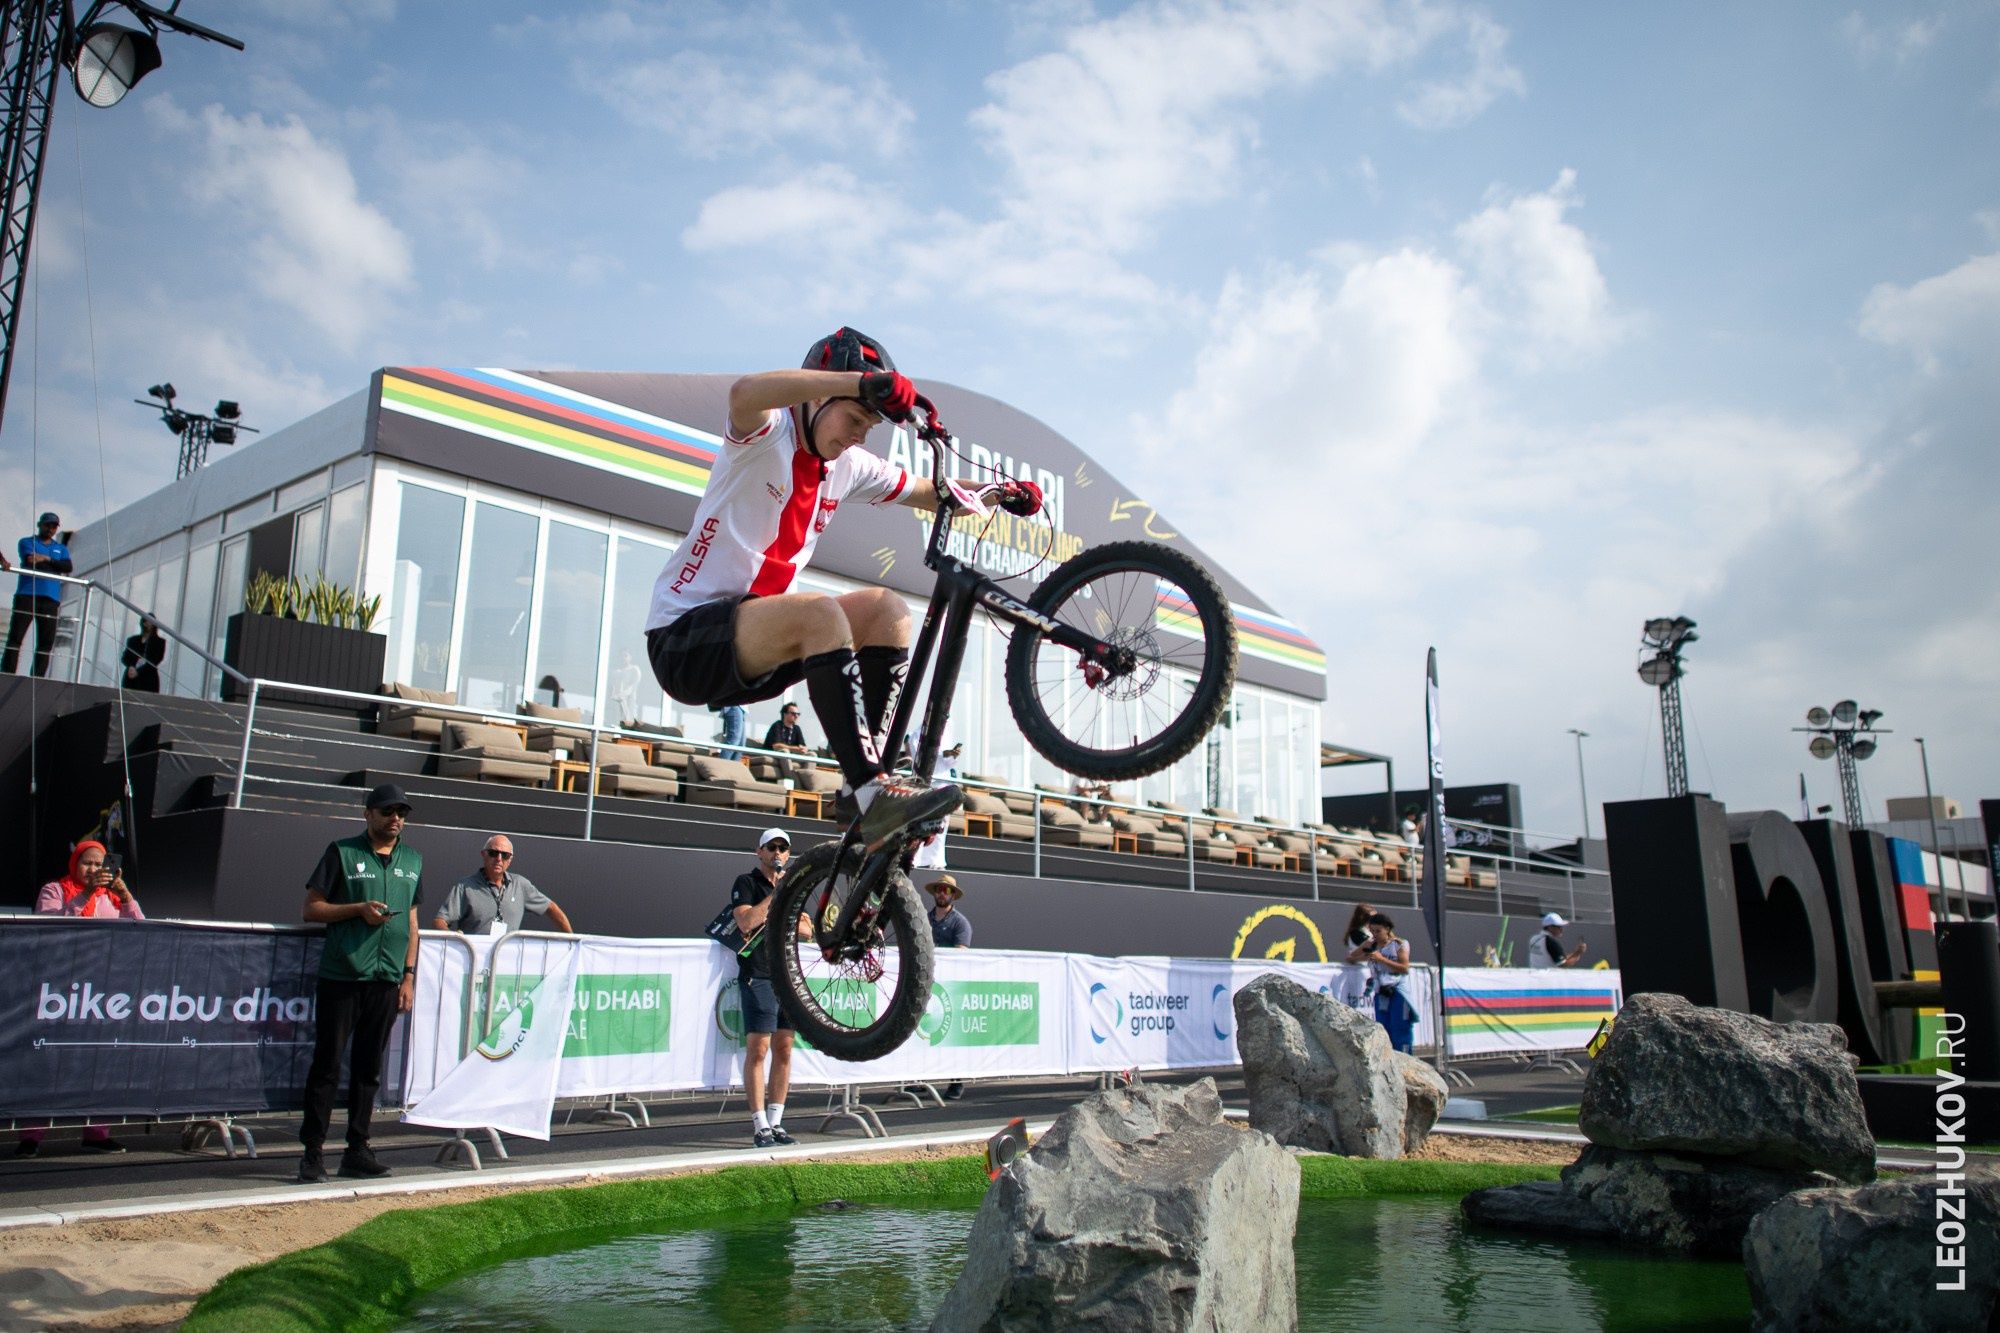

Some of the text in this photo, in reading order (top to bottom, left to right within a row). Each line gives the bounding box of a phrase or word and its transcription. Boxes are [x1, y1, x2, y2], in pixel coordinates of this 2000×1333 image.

[937, 507, 953, 551] CLEAN
[1016, 517, 1084, 563] CYCLING
[921, 521, 979, 565] WRLD
[670, 517, 720, 594] POLSKA
[37, 982, 316, 1022] bike abu dha
[571, 989, 660, 1012] BU DHABI
[961, 994, 1033, 1010] ABU DHABI
[1129, 991, 1189, 1010] tadweer
[566, 1019, 587, 1040] AE
[941, 1015, 951, 1035] CITY
[961, 1016, 988, 1033] UAE
[1131, 1015, 1175, 1036] group
